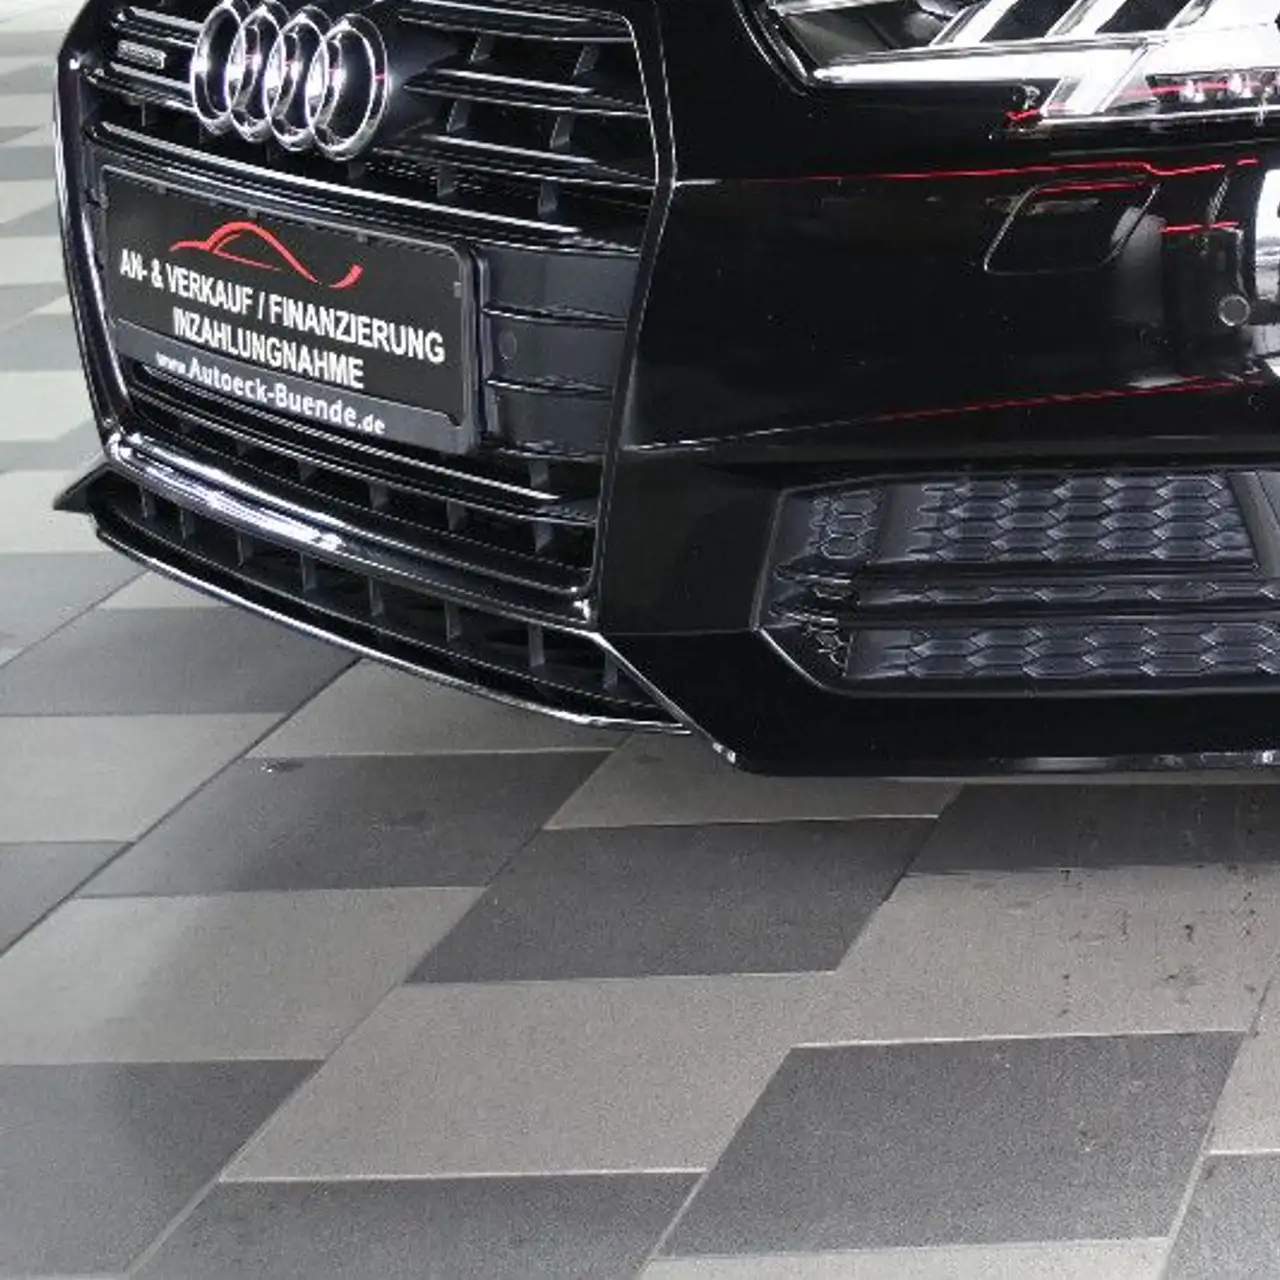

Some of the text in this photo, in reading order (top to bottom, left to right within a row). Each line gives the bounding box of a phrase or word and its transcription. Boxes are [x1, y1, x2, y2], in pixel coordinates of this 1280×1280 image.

[119, 248, 446, 364] AN- & VERKAUF / FINANZIERUNG
[172, 306, 364, 390] INZAHLUNGNAHME
